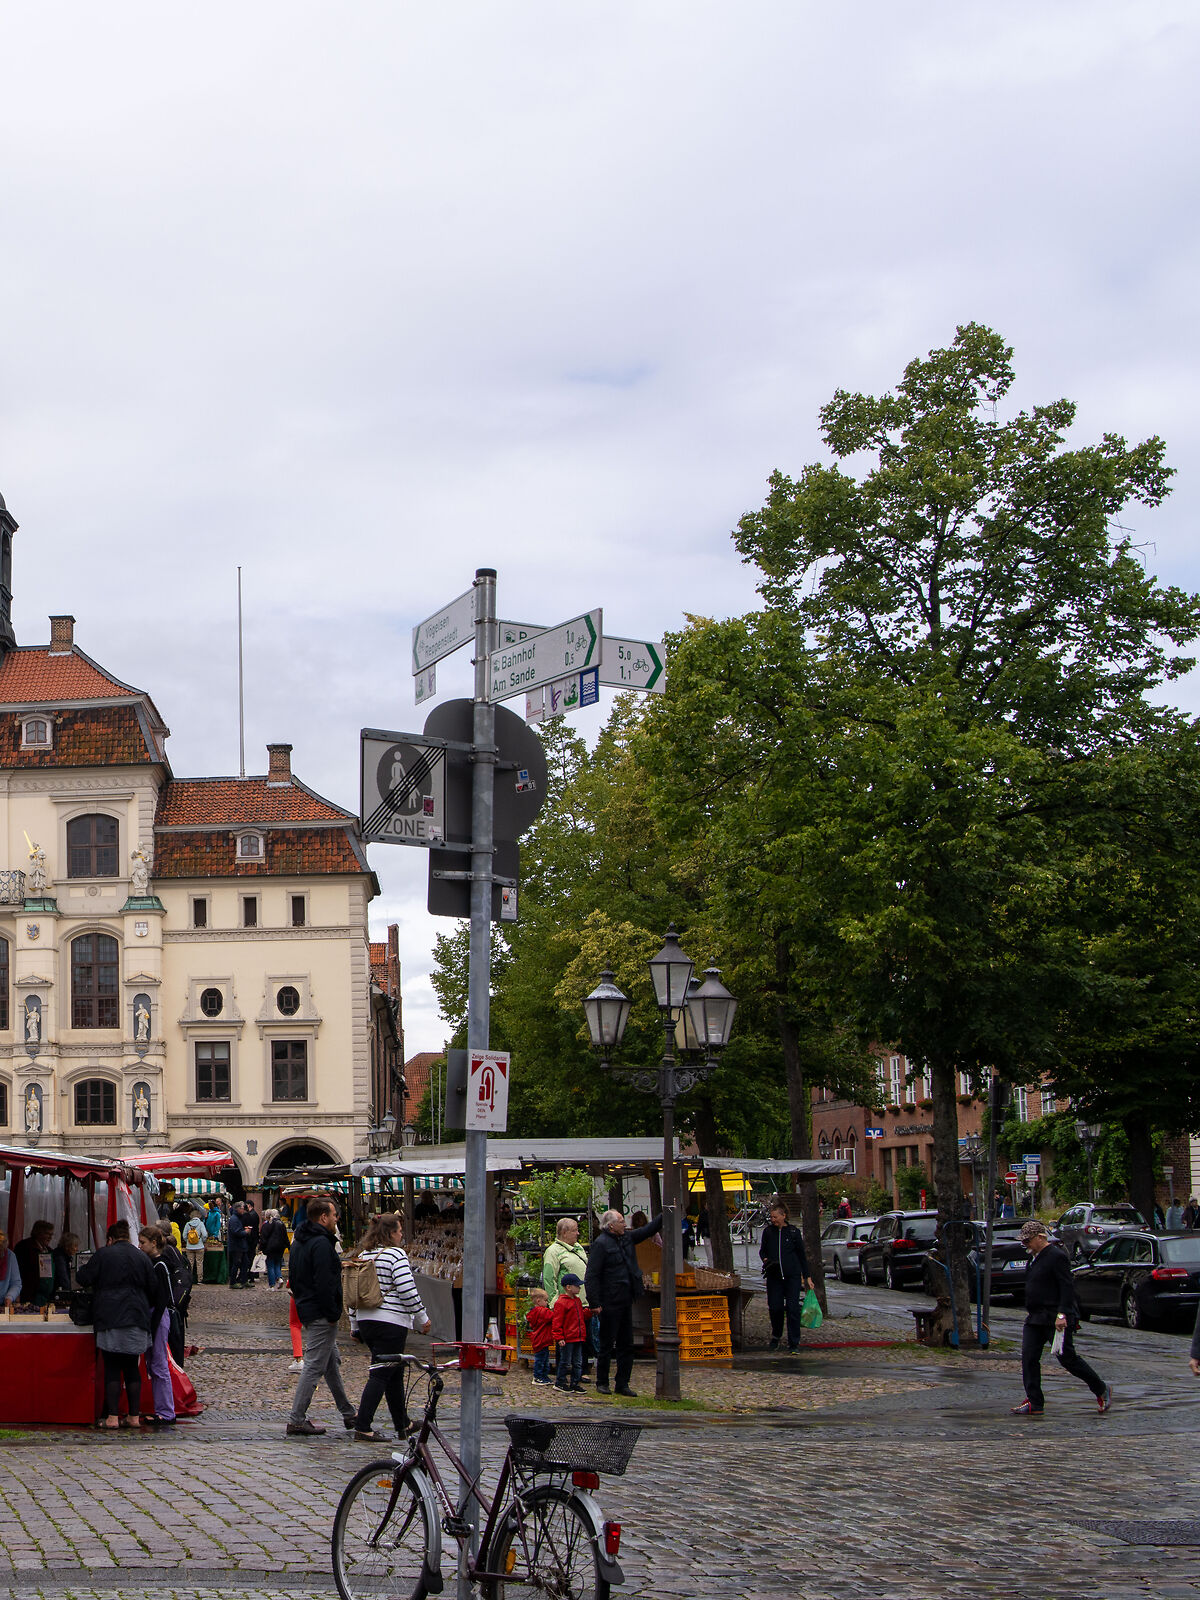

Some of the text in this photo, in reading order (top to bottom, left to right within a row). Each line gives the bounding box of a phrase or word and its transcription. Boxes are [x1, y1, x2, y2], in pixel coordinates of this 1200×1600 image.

[501, 643, 536, 670] Bahnhof
[492, 666, 536, 694] Am Sande
[383, 817, 426, 838] ZONE
